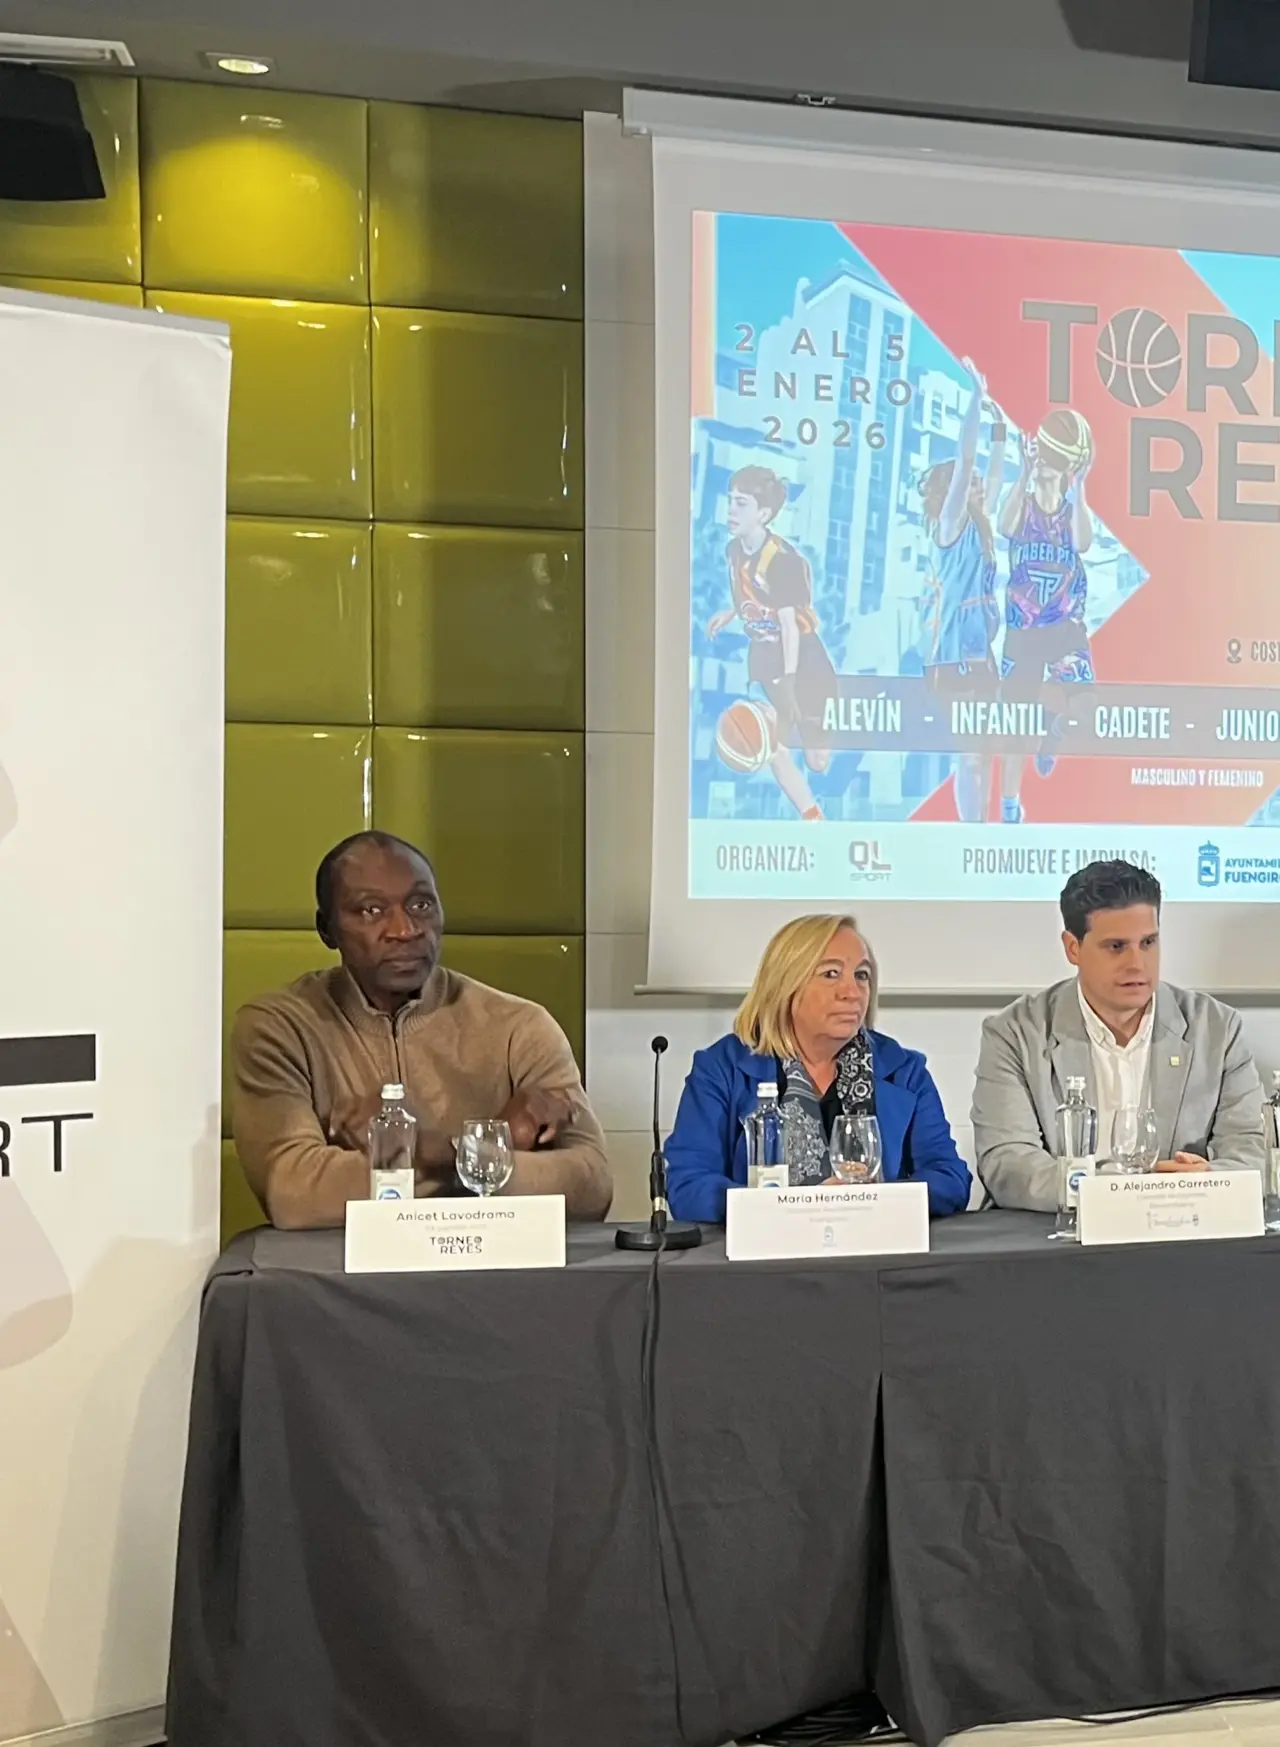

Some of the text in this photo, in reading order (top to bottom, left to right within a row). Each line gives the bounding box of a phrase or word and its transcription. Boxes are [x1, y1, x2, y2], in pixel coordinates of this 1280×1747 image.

[734, 324, 905, 362] 2 AL 5
[738, 369, 912, 407] ENERO
[762, 415, 886, 450] 2026
[823, 692, 901, 733] ALEVÍN
[951, 701, 1048, 738] INFANTIL
[1095, 704, 1171, 740] CADETE
[1130, 766, 1197, 787] MASCULINO
[1208, 768, 1264, 788] FEMENINO
[715, 844, 816, 872] ORGANIZA:
[849, 840, 893, 871] QL
[962, 847, 1057, 875] PROMUEVE
[1061, 848, 1071, 875] E
[778, 1191, 878, 1205] María Hernández
[1123, 1180, 1176, 1193] Alejandro
[1178, 1179, 1231, 1189] Carretero
[396, 1210, 515, 1222] Anicet Lavodrama
[440, 1245, 482, 1255] REYES
